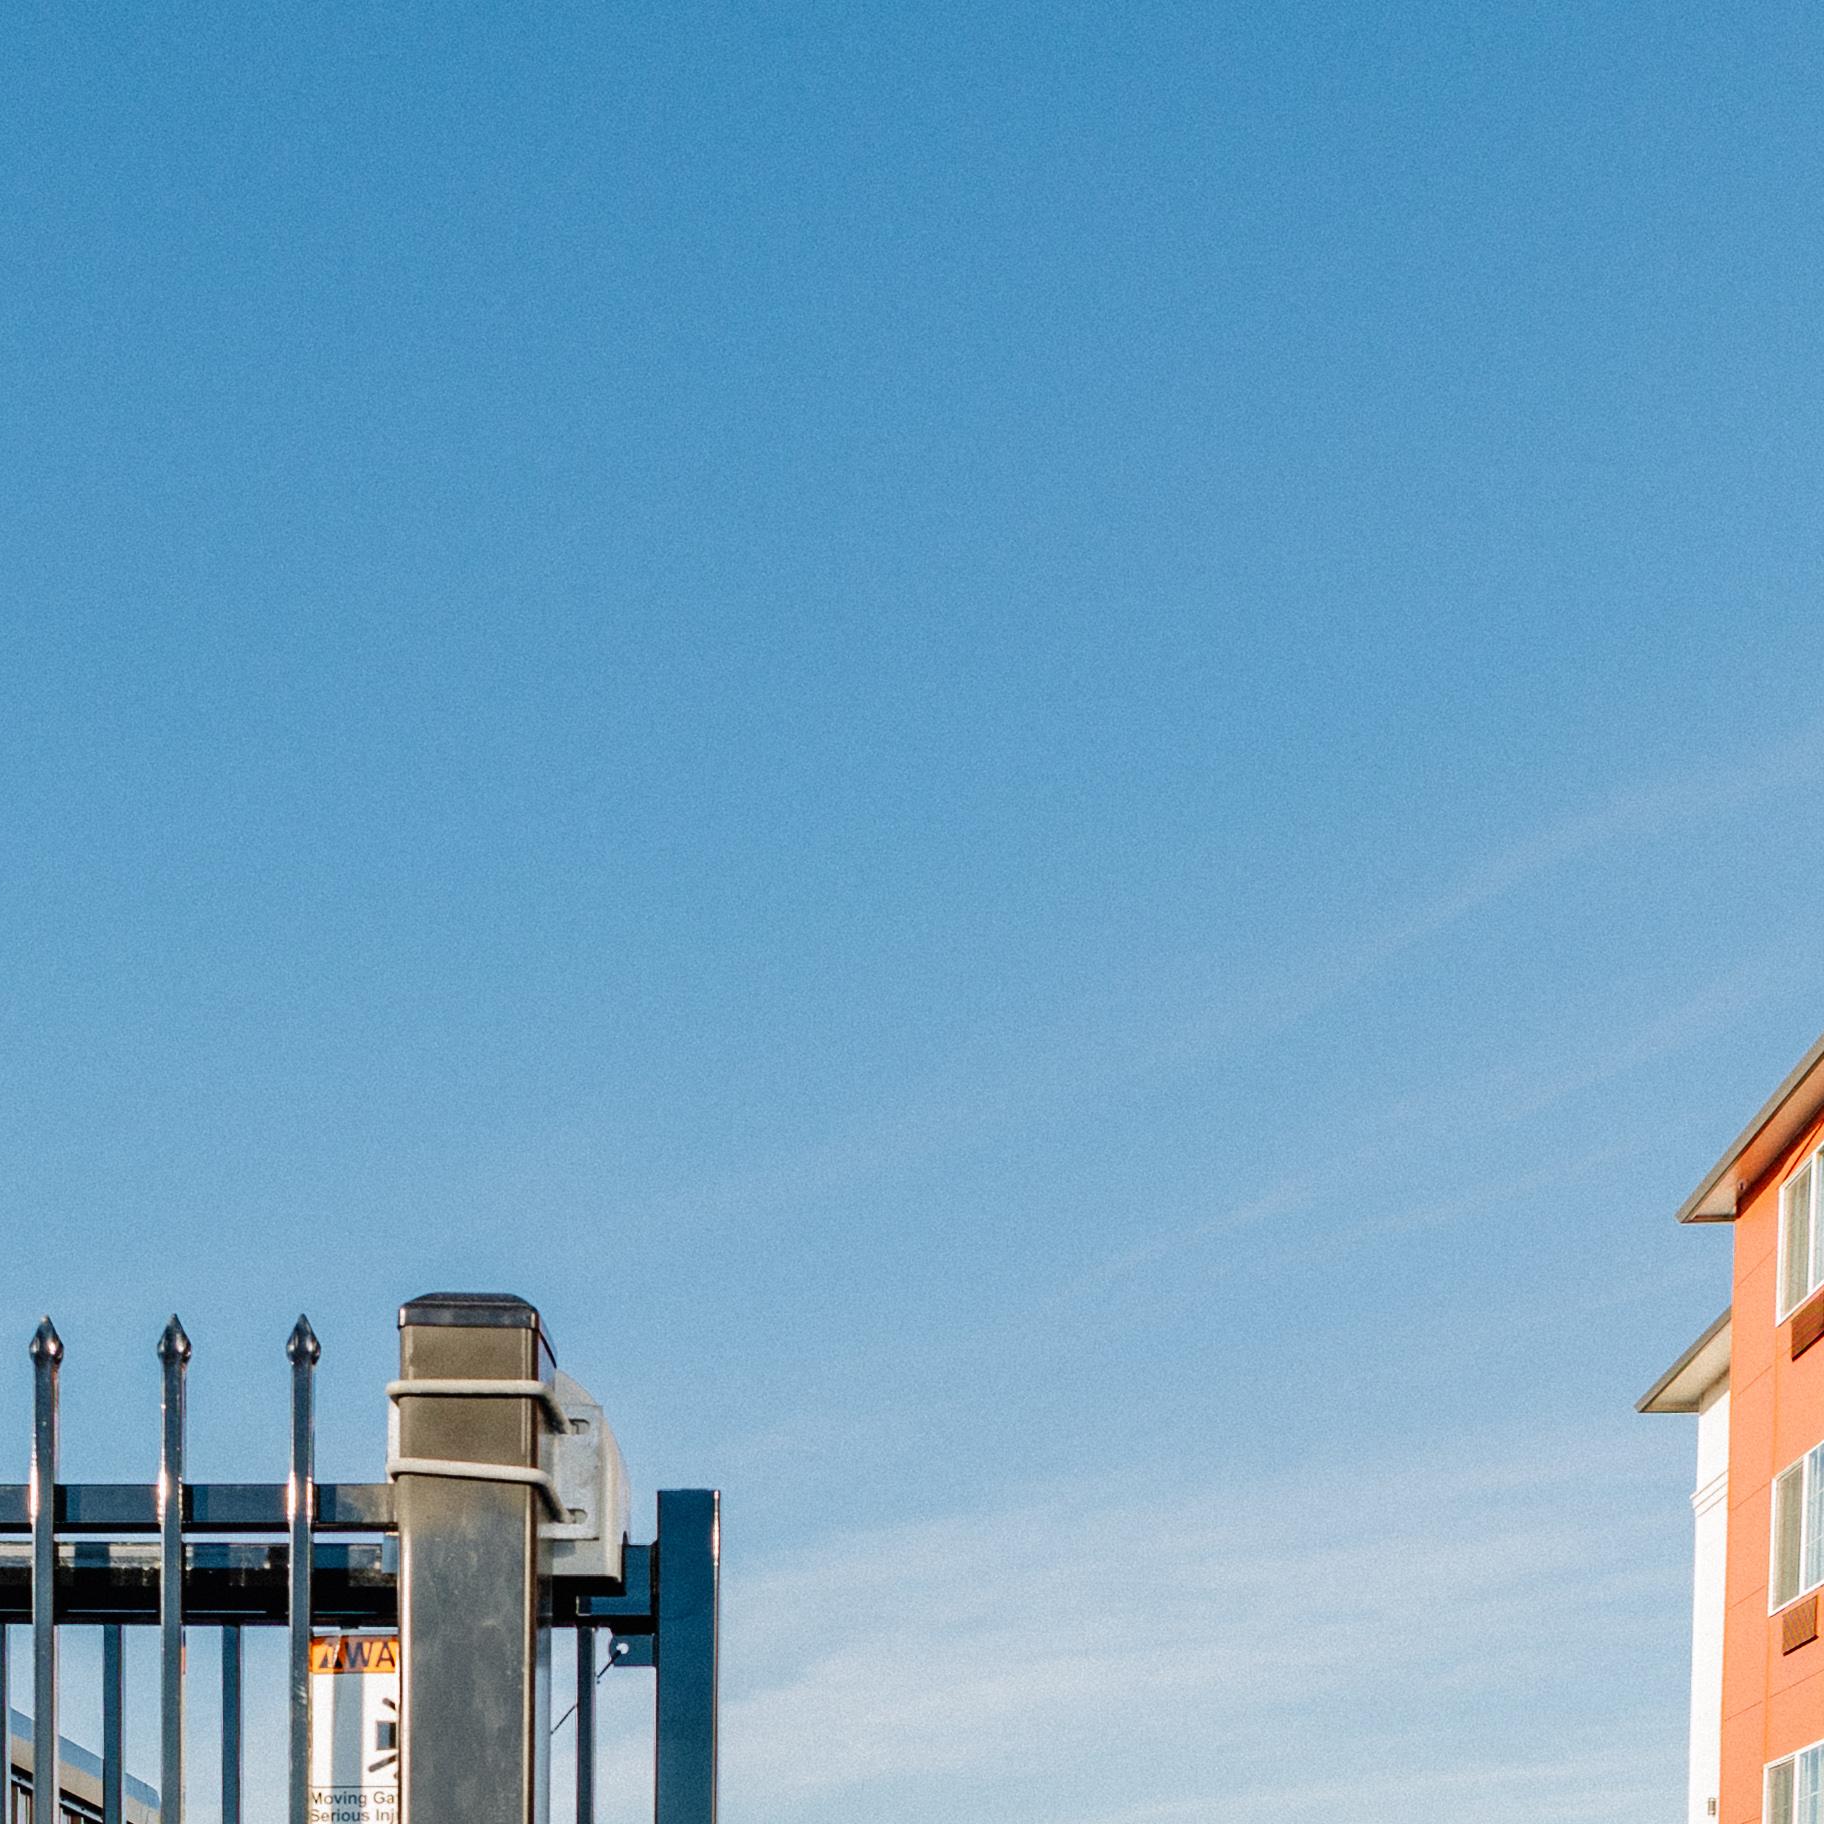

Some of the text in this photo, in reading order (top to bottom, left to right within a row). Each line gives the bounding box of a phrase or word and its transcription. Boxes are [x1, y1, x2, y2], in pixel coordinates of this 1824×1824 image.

[344, 1641, 396, 1668] WA
[311, 1791, 395, 1807] Moving Ga
[310, 1808, 395, 1824] Serious Inj
